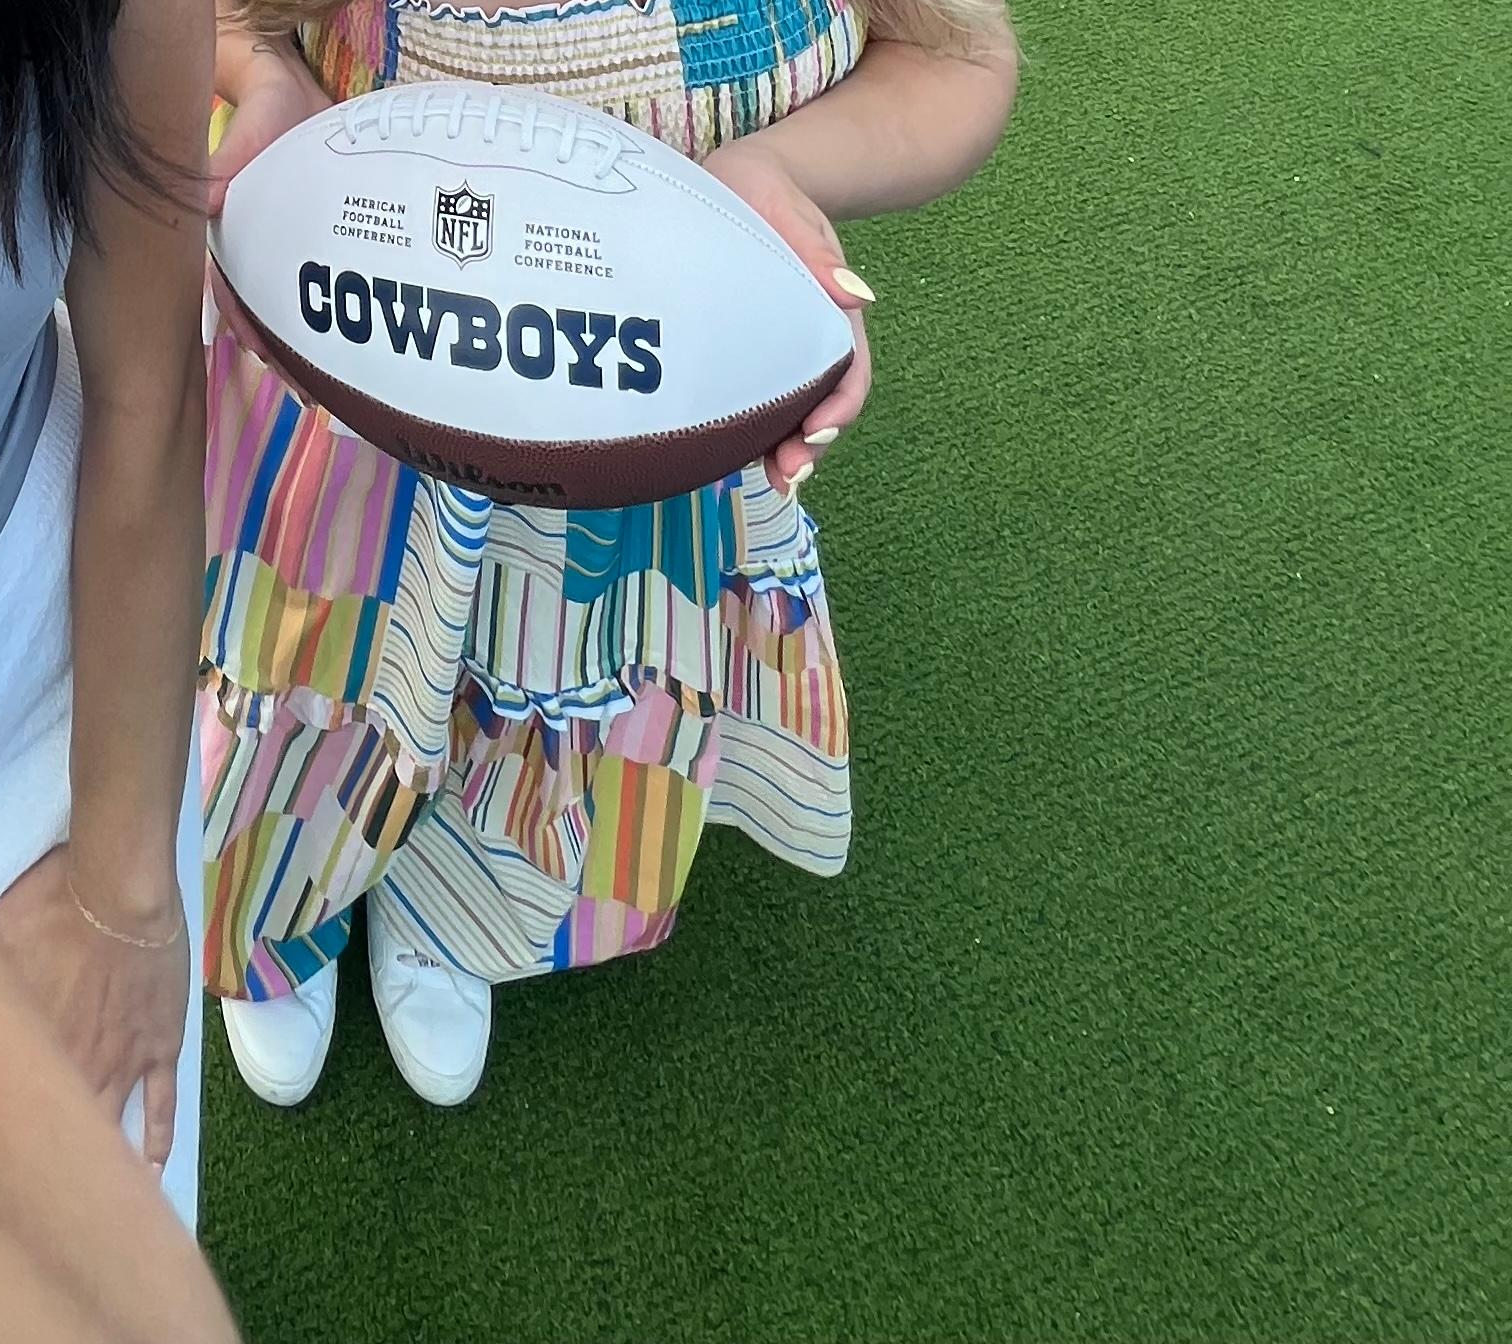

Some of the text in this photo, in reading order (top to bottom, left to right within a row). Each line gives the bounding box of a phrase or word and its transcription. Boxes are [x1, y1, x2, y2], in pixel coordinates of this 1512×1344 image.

[343, 195, 407, 215] AMERICAN
[342, 210, 405, 231] FOOTBALL
[332, 224, 413, 248] CONFERENCE
[439, 216, 485, 255] NFL
[524, 223, 601, 244] NATIONAL
[523, 239, 603, 261] FOOTBALL
[514, 254, 614, 279] CONFERENCE
[298, 260, 663, 395] COWBOYS
